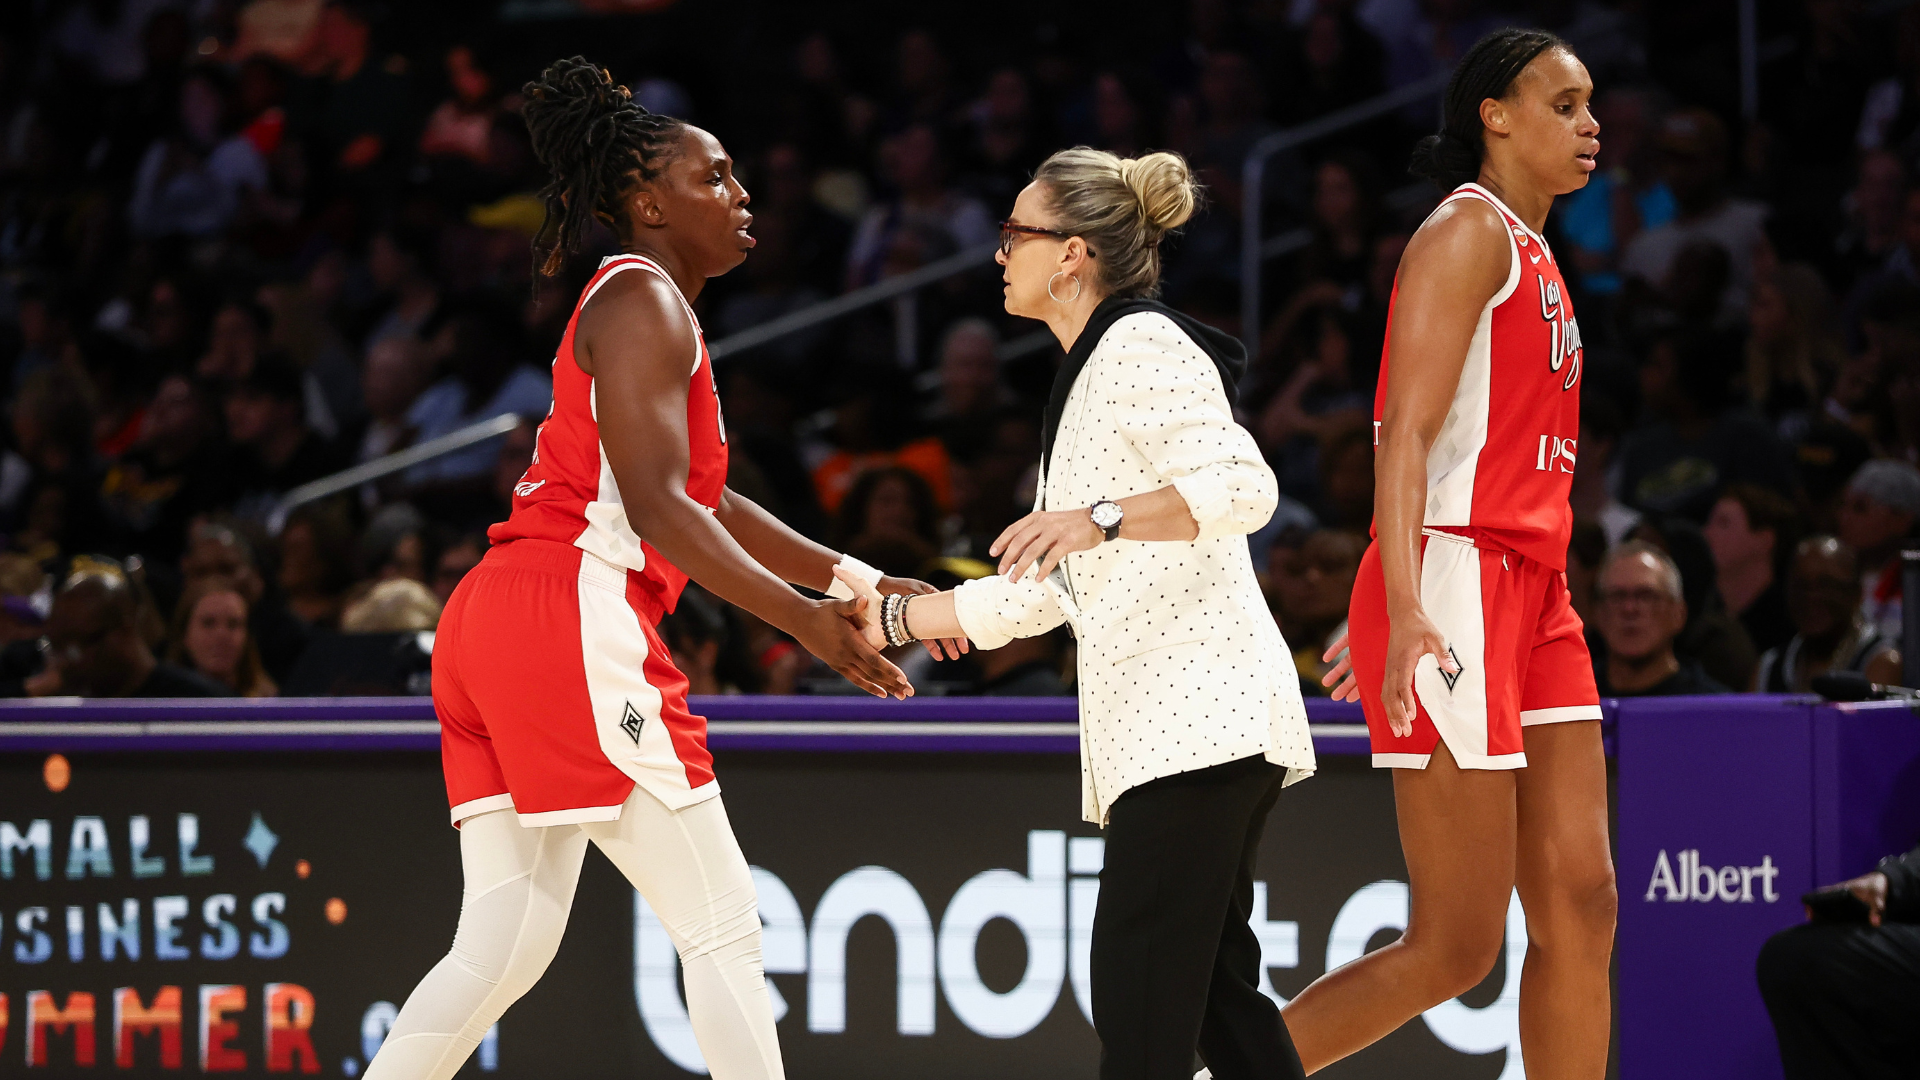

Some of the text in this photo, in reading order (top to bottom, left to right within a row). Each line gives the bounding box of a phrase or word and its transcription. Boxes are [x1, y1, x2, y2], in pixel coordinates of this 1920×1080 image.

[1550, 310, 1583, 391] Vega
[1535, 434, 1577, 474] IPS
[1644, 849, 1779, 903] Albert
[0, 891, 291, 964] SINESS
[0, 982, 321, 1073] MMER
